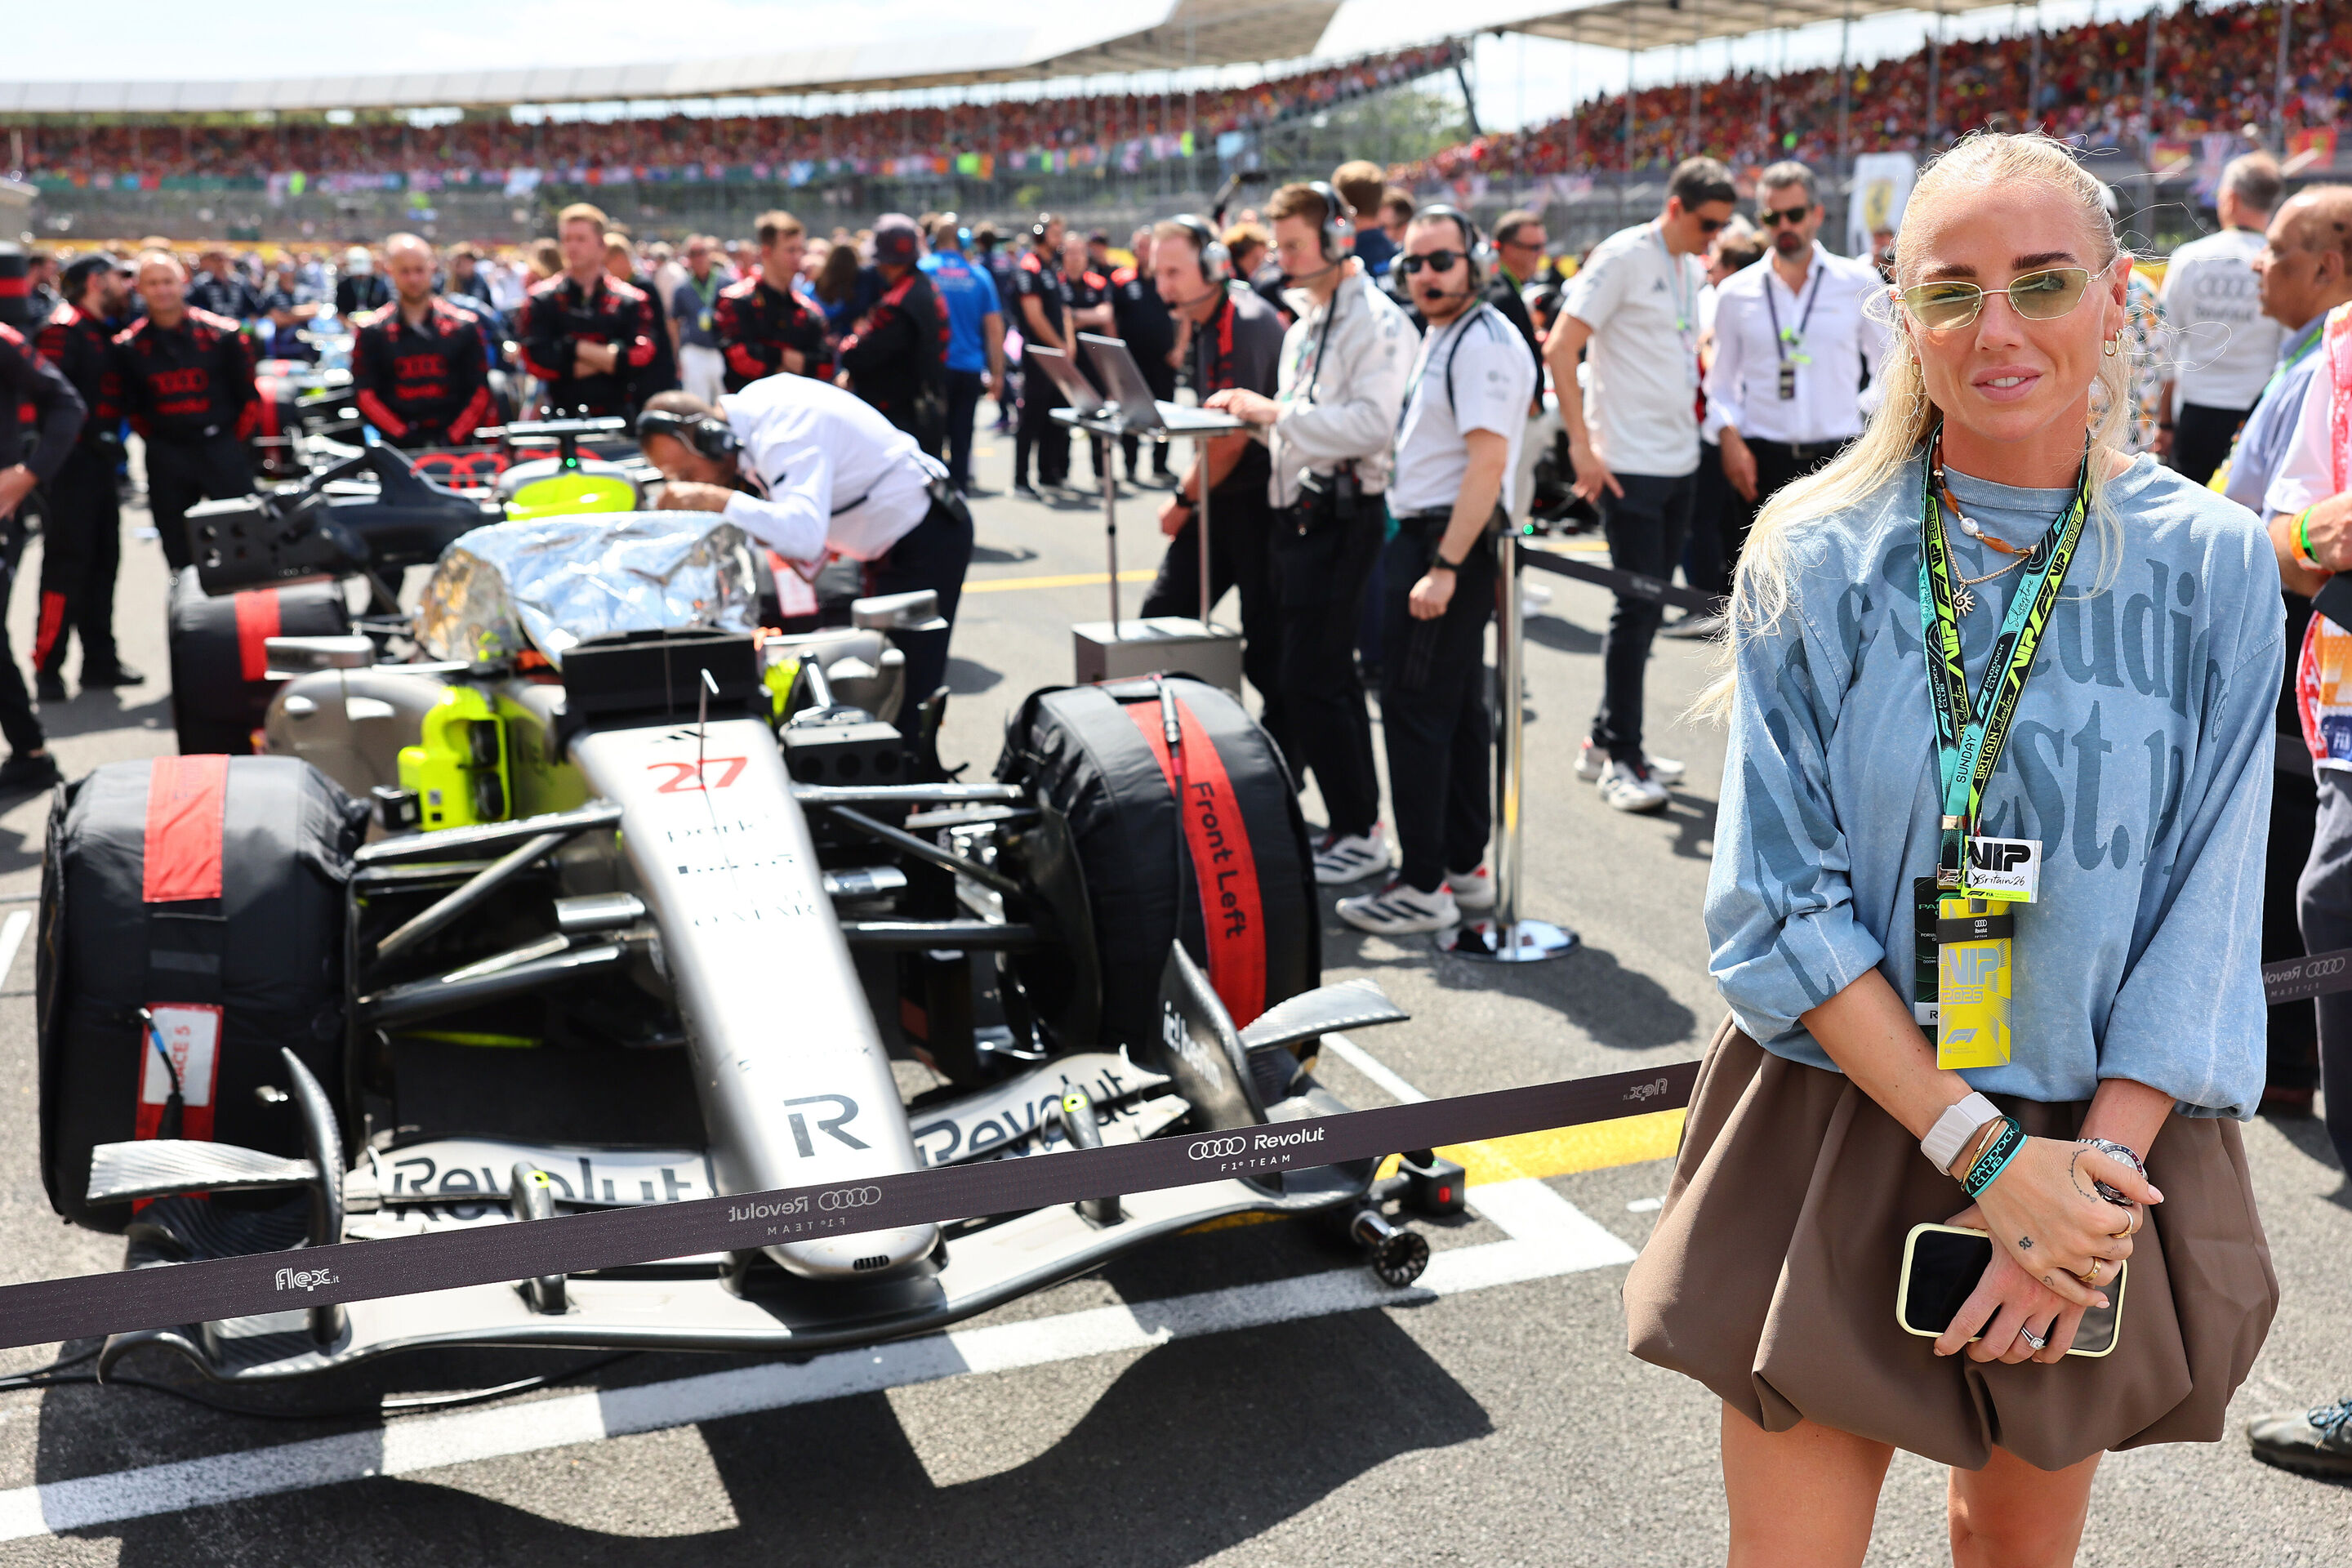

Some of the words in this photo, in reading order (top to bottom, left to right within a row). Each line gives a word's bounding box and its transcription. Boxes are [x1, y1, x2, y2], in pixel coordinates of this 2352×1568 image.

[2065, 511, 2082, 554] 2026
[1984, 643, 2004, 688] PADDOCK
[1989, 664, 2002, 689] CLUB
[1931, 664, 1944, 709] PADDOCK
[1940, 683, 1949, 708] CLUB
[1957, 734, 1977, 783] SUNDAY
[1975, 731, 1999, 780] BRITAIN
[647, 756, 748, 794] 27
[1190, 781, 1234, 865] Front
[1216, 869, 1248, 939] Left
[1968, 841, 2032, 872] VIP
[1946, 947, 2000, 986] VIP
[1940, 986, 1984, 1005] 2026
[783, 1093, 874, 1158] R
[1254, 1126, 1325, 1151] Revolut
[1250, 1154, 1291, 1168] TEAM
[1969, 1128, 2017, 1183] PADDOCK
[1975, 1156, 2004, 1187] CLUB
[274, 1267, 341, 1292] flex.it
